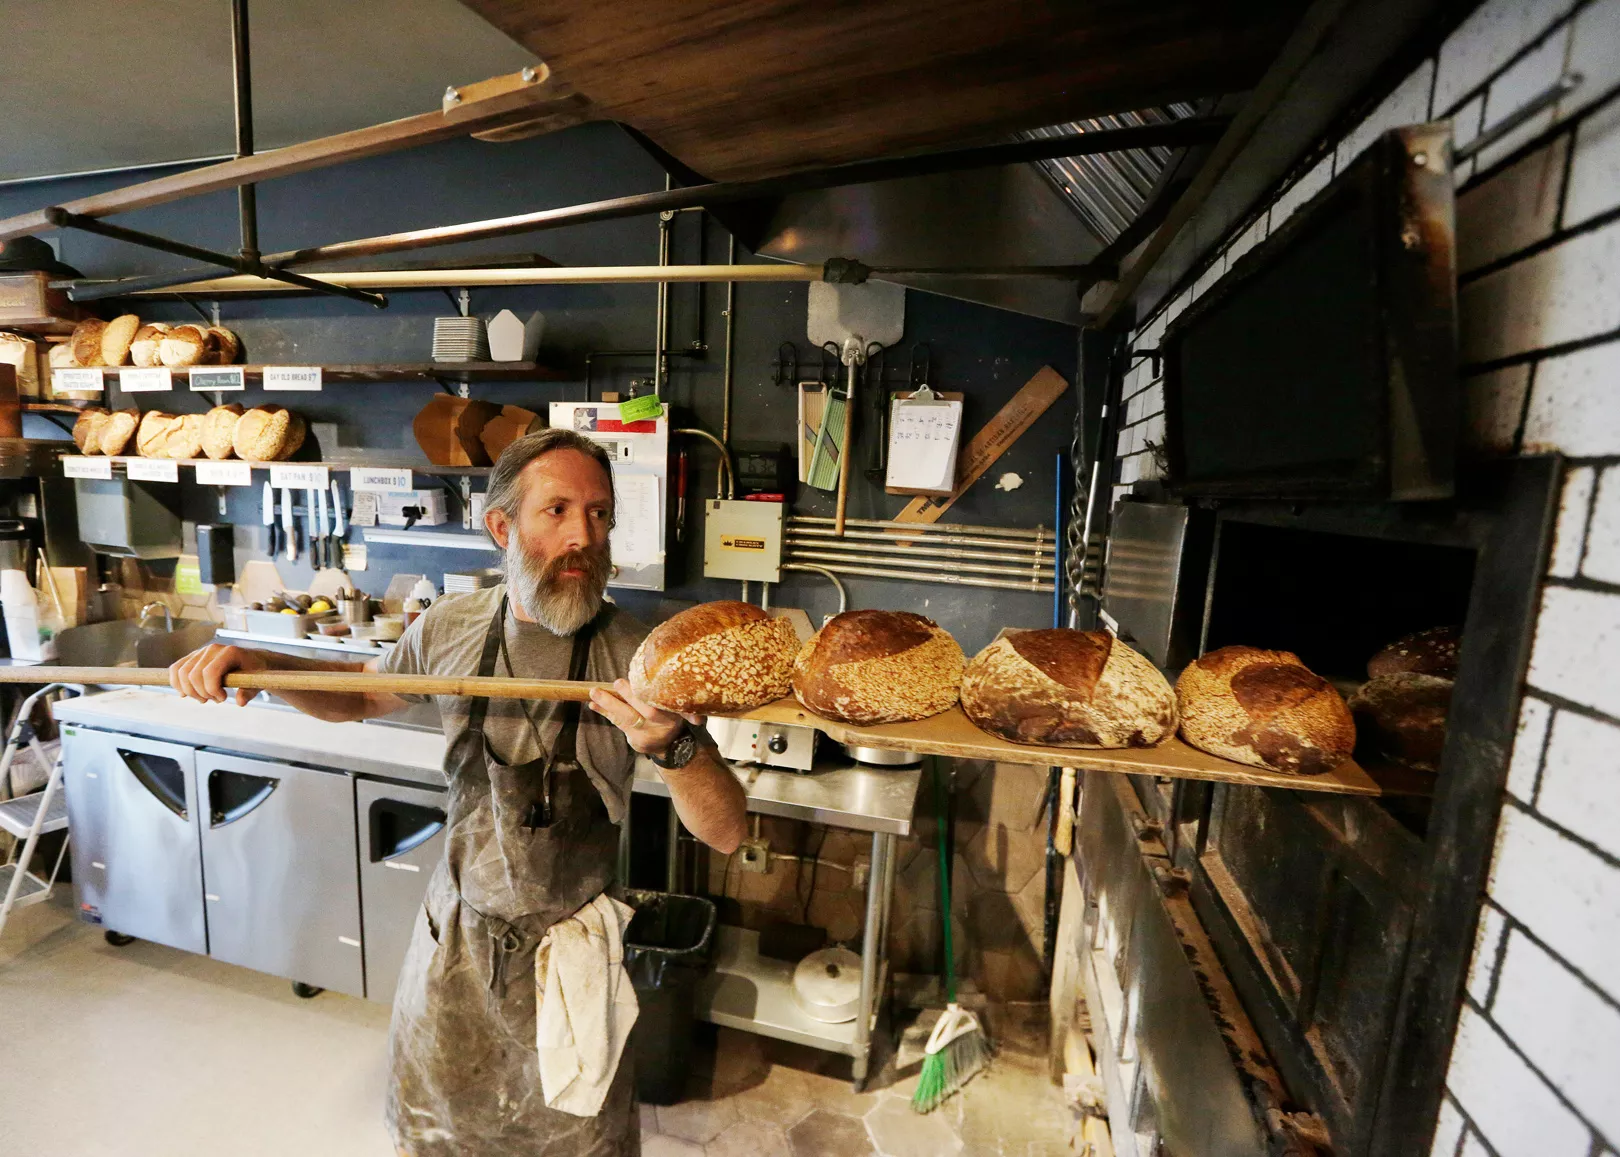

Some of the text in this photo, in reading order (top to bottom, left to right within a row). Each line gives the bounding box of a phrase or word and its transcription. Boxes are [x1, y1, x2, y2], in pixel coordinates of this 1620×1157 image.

[270, 373, 280, 381] DAY
[281, 373, 290, 381] OLD
[291, 373, 307, 381] BREAD
[984, 428, 1005, 450] ARTISAN
[363, 476, 391, 485] LUNCHBOX
